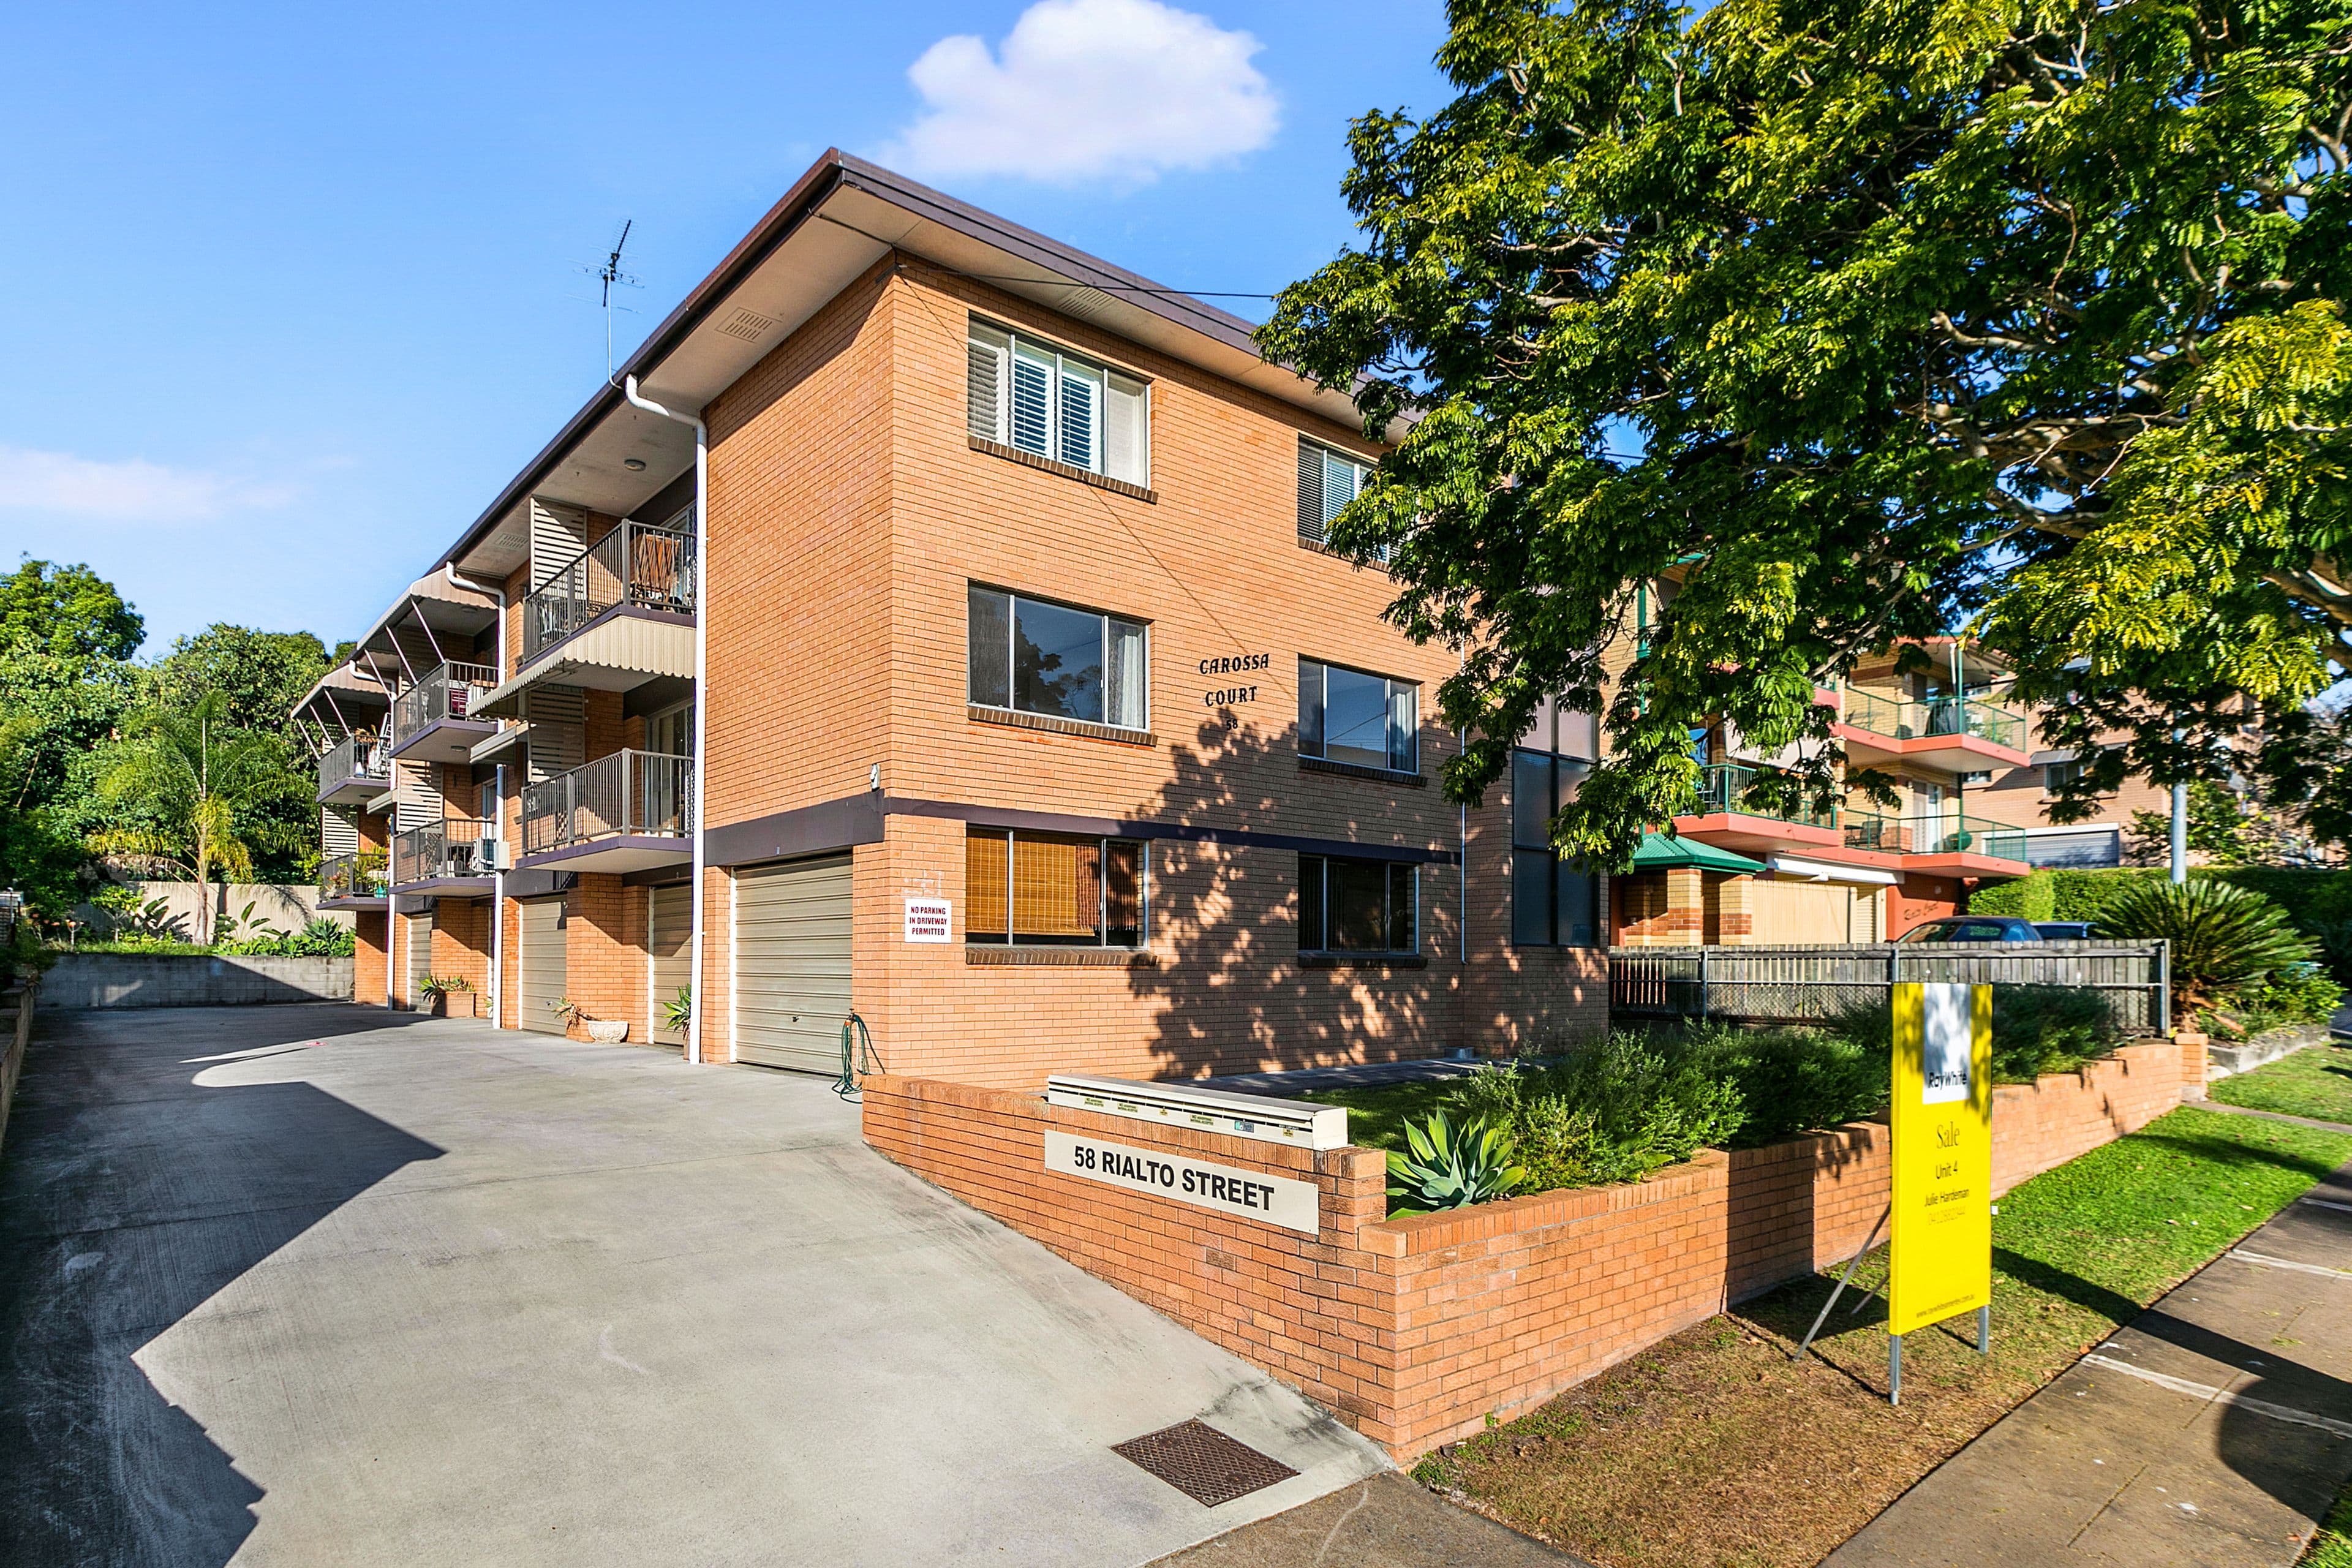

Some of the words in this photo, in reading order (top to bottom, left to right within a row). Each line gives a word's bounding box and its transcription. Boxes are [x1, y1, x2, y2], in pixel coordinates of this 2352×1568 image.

[1199, 653, 1270, 674] CAROSSA
[1205, 686, 1257, 707] COURT
[1226, 718, 1238, 731] 58
[1937, 1121, 1960, 1149] Sale
[1074, 1145, 1096, 1170] 58
[1102, 1151, 1175, 1188] RIALTO
[1182, 1167, 1275, 1211] STREET
[1936, 1163, 1951, 1179] Unit
[1953, 1160, 1958, 1175] 4
[1924, 1193, 1939, 1207] Julie
